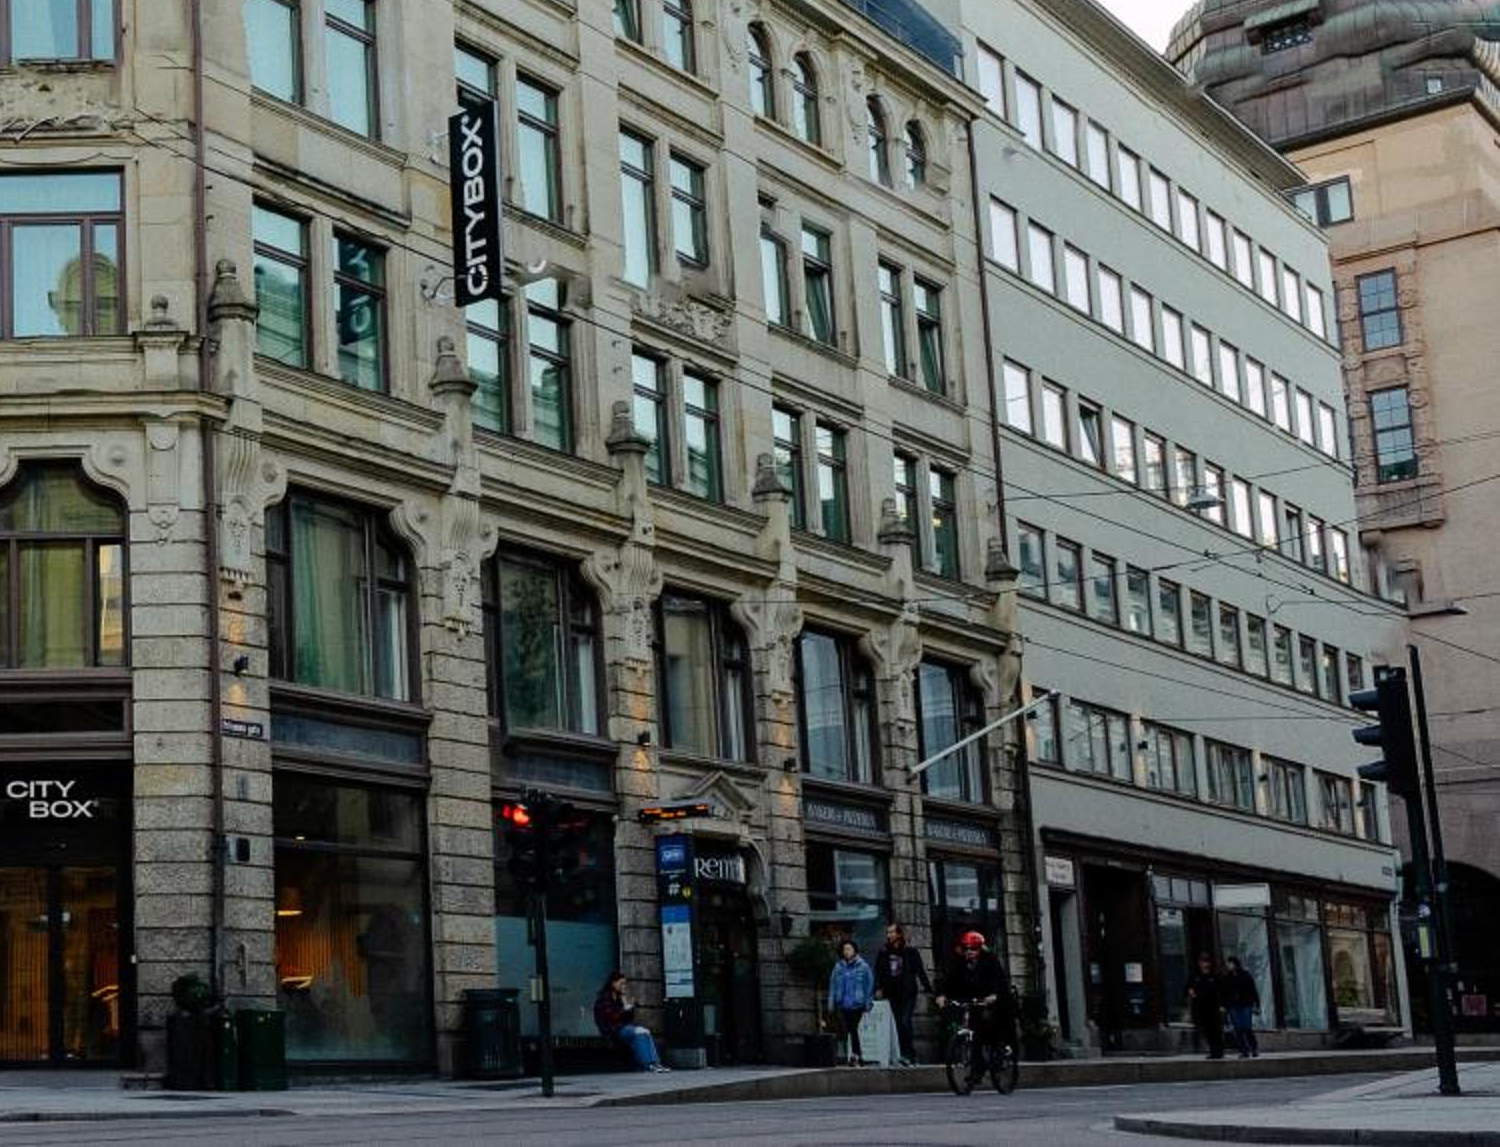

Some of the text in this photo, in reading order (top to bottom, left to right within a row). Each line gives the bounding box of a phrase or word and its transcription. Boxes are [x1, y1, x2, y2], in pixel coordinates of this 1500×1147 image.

[461, 117, 489, 296] CITYBOX
[6, 780, 76, 799] CITY
[29, 799, 94, 819] BOX
